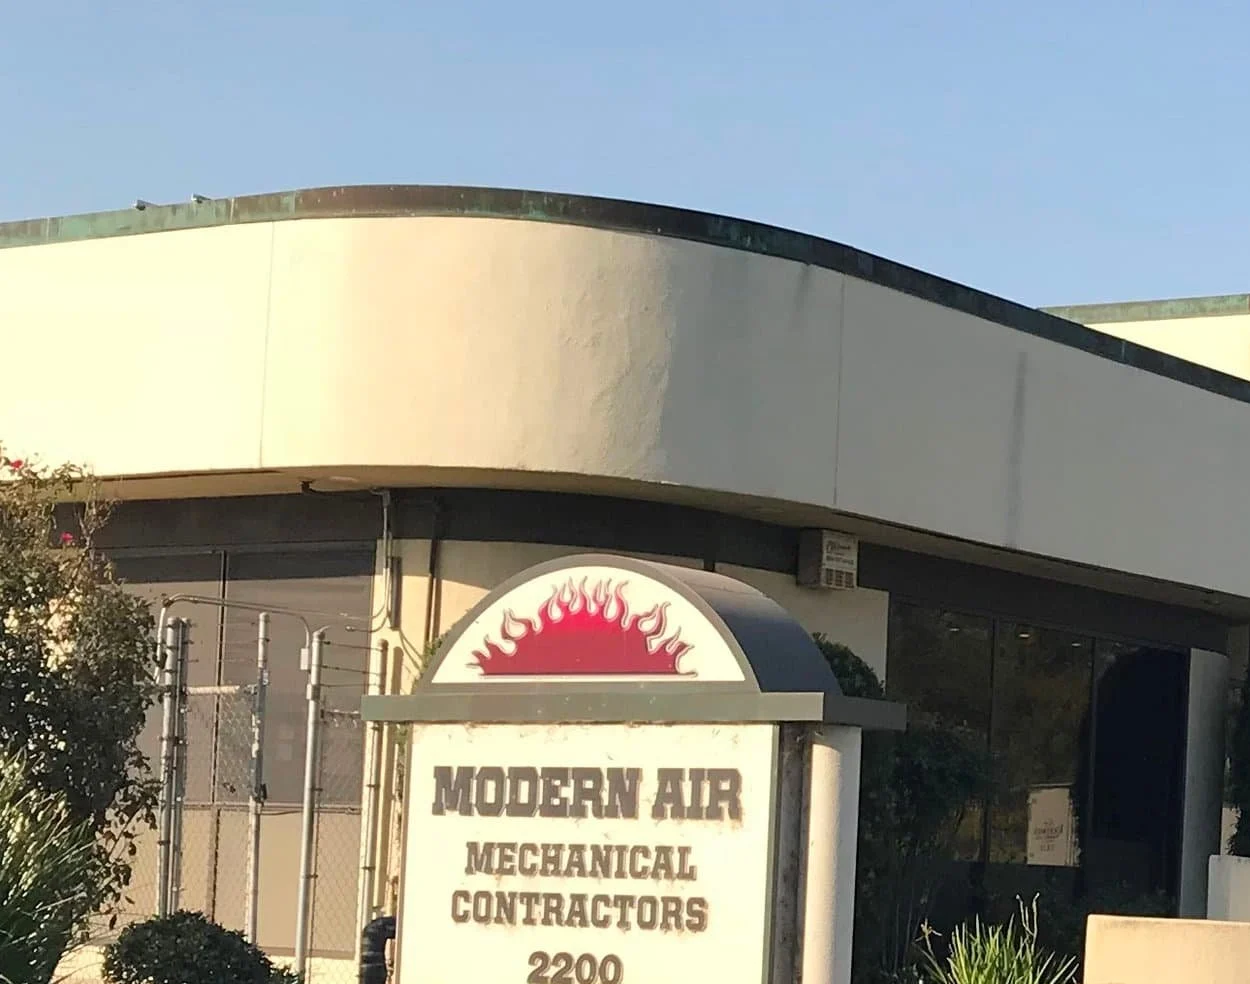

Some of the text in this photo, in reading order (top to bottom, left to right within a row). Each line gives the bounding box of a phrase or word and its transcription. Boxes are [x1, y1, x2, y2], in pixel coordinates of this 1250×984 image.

[432, 765, 743, 821] MODERN AIR
[464, 841, 698, 881] MECHANICAL
[451, 889, 709, 932] CONTRACTORS
